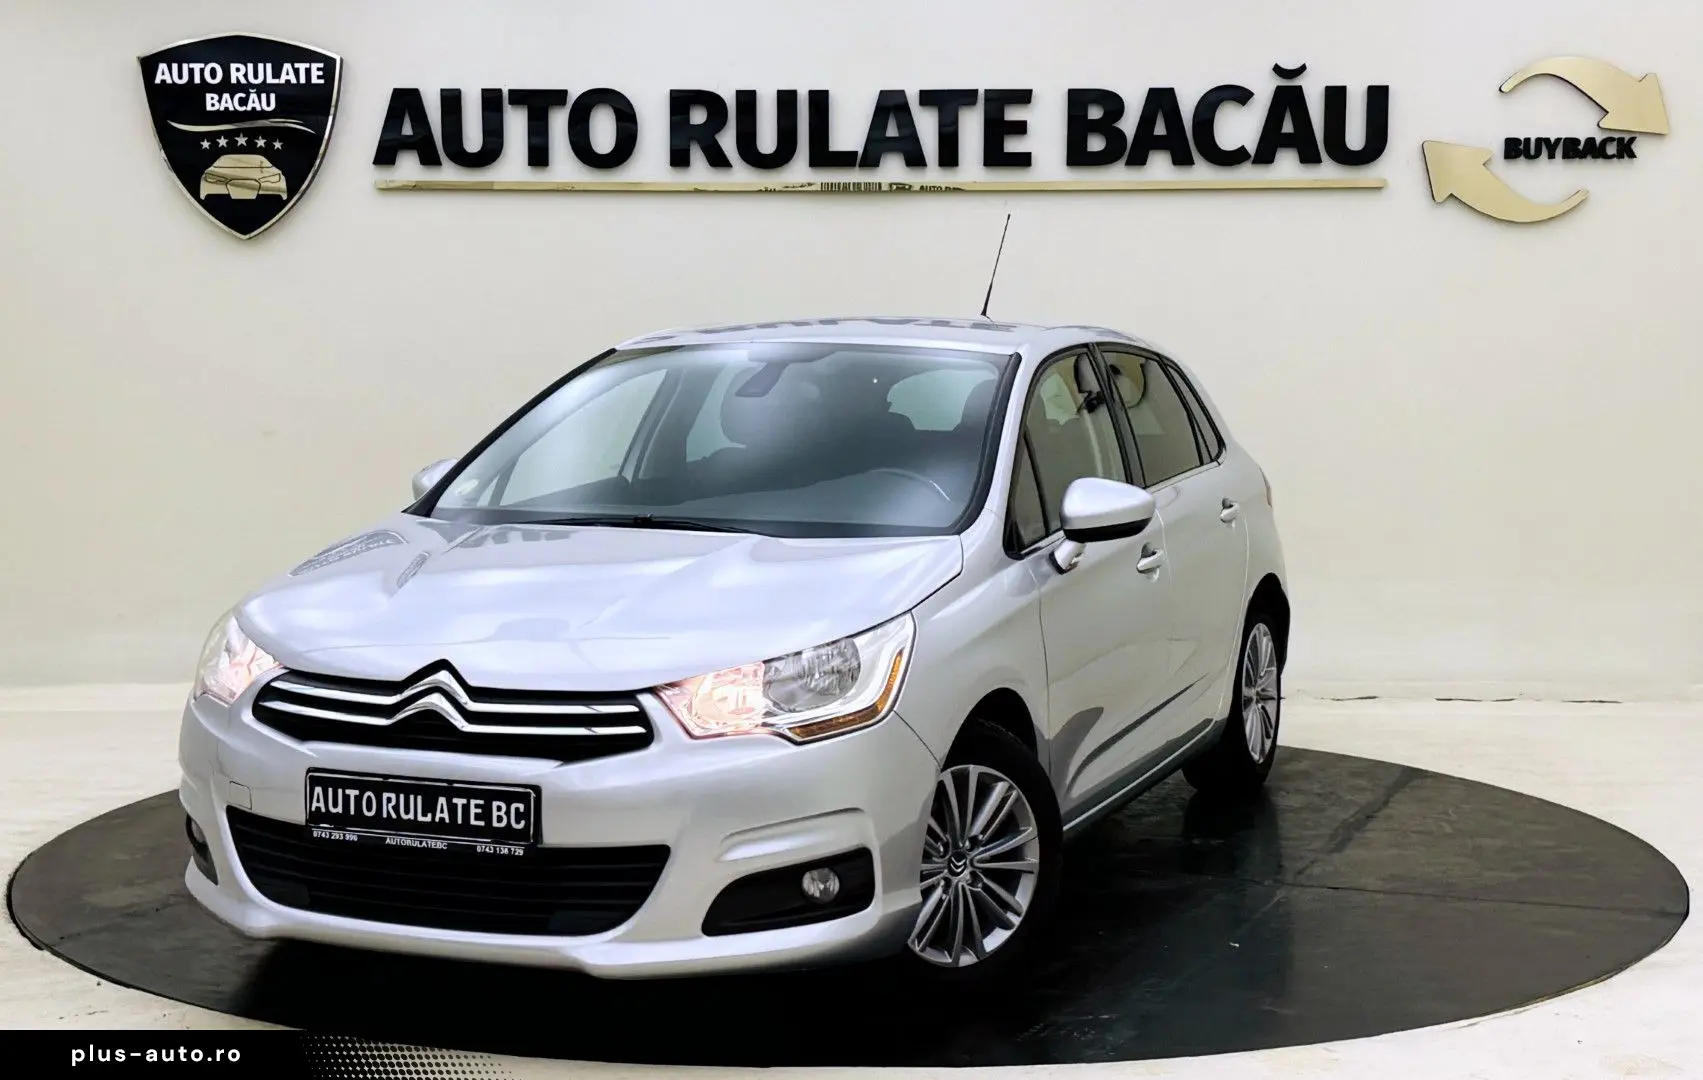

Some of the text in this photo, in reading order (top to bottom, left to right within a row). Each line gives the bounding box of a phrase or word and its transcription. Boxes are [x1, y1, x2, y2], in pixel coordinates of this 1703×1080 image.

[154, 63, 325, 84] AUTO RULATE
[205, 89, 276, 111] BACĂU
[373, 63, 1390, 170] AUTO RULATE BACĂU
[1503, 136, 1637, 160] BUYBACK
[311, 786, 525, 830] AUTO RULATE BC
[313, 830, 330, 838] 0743
